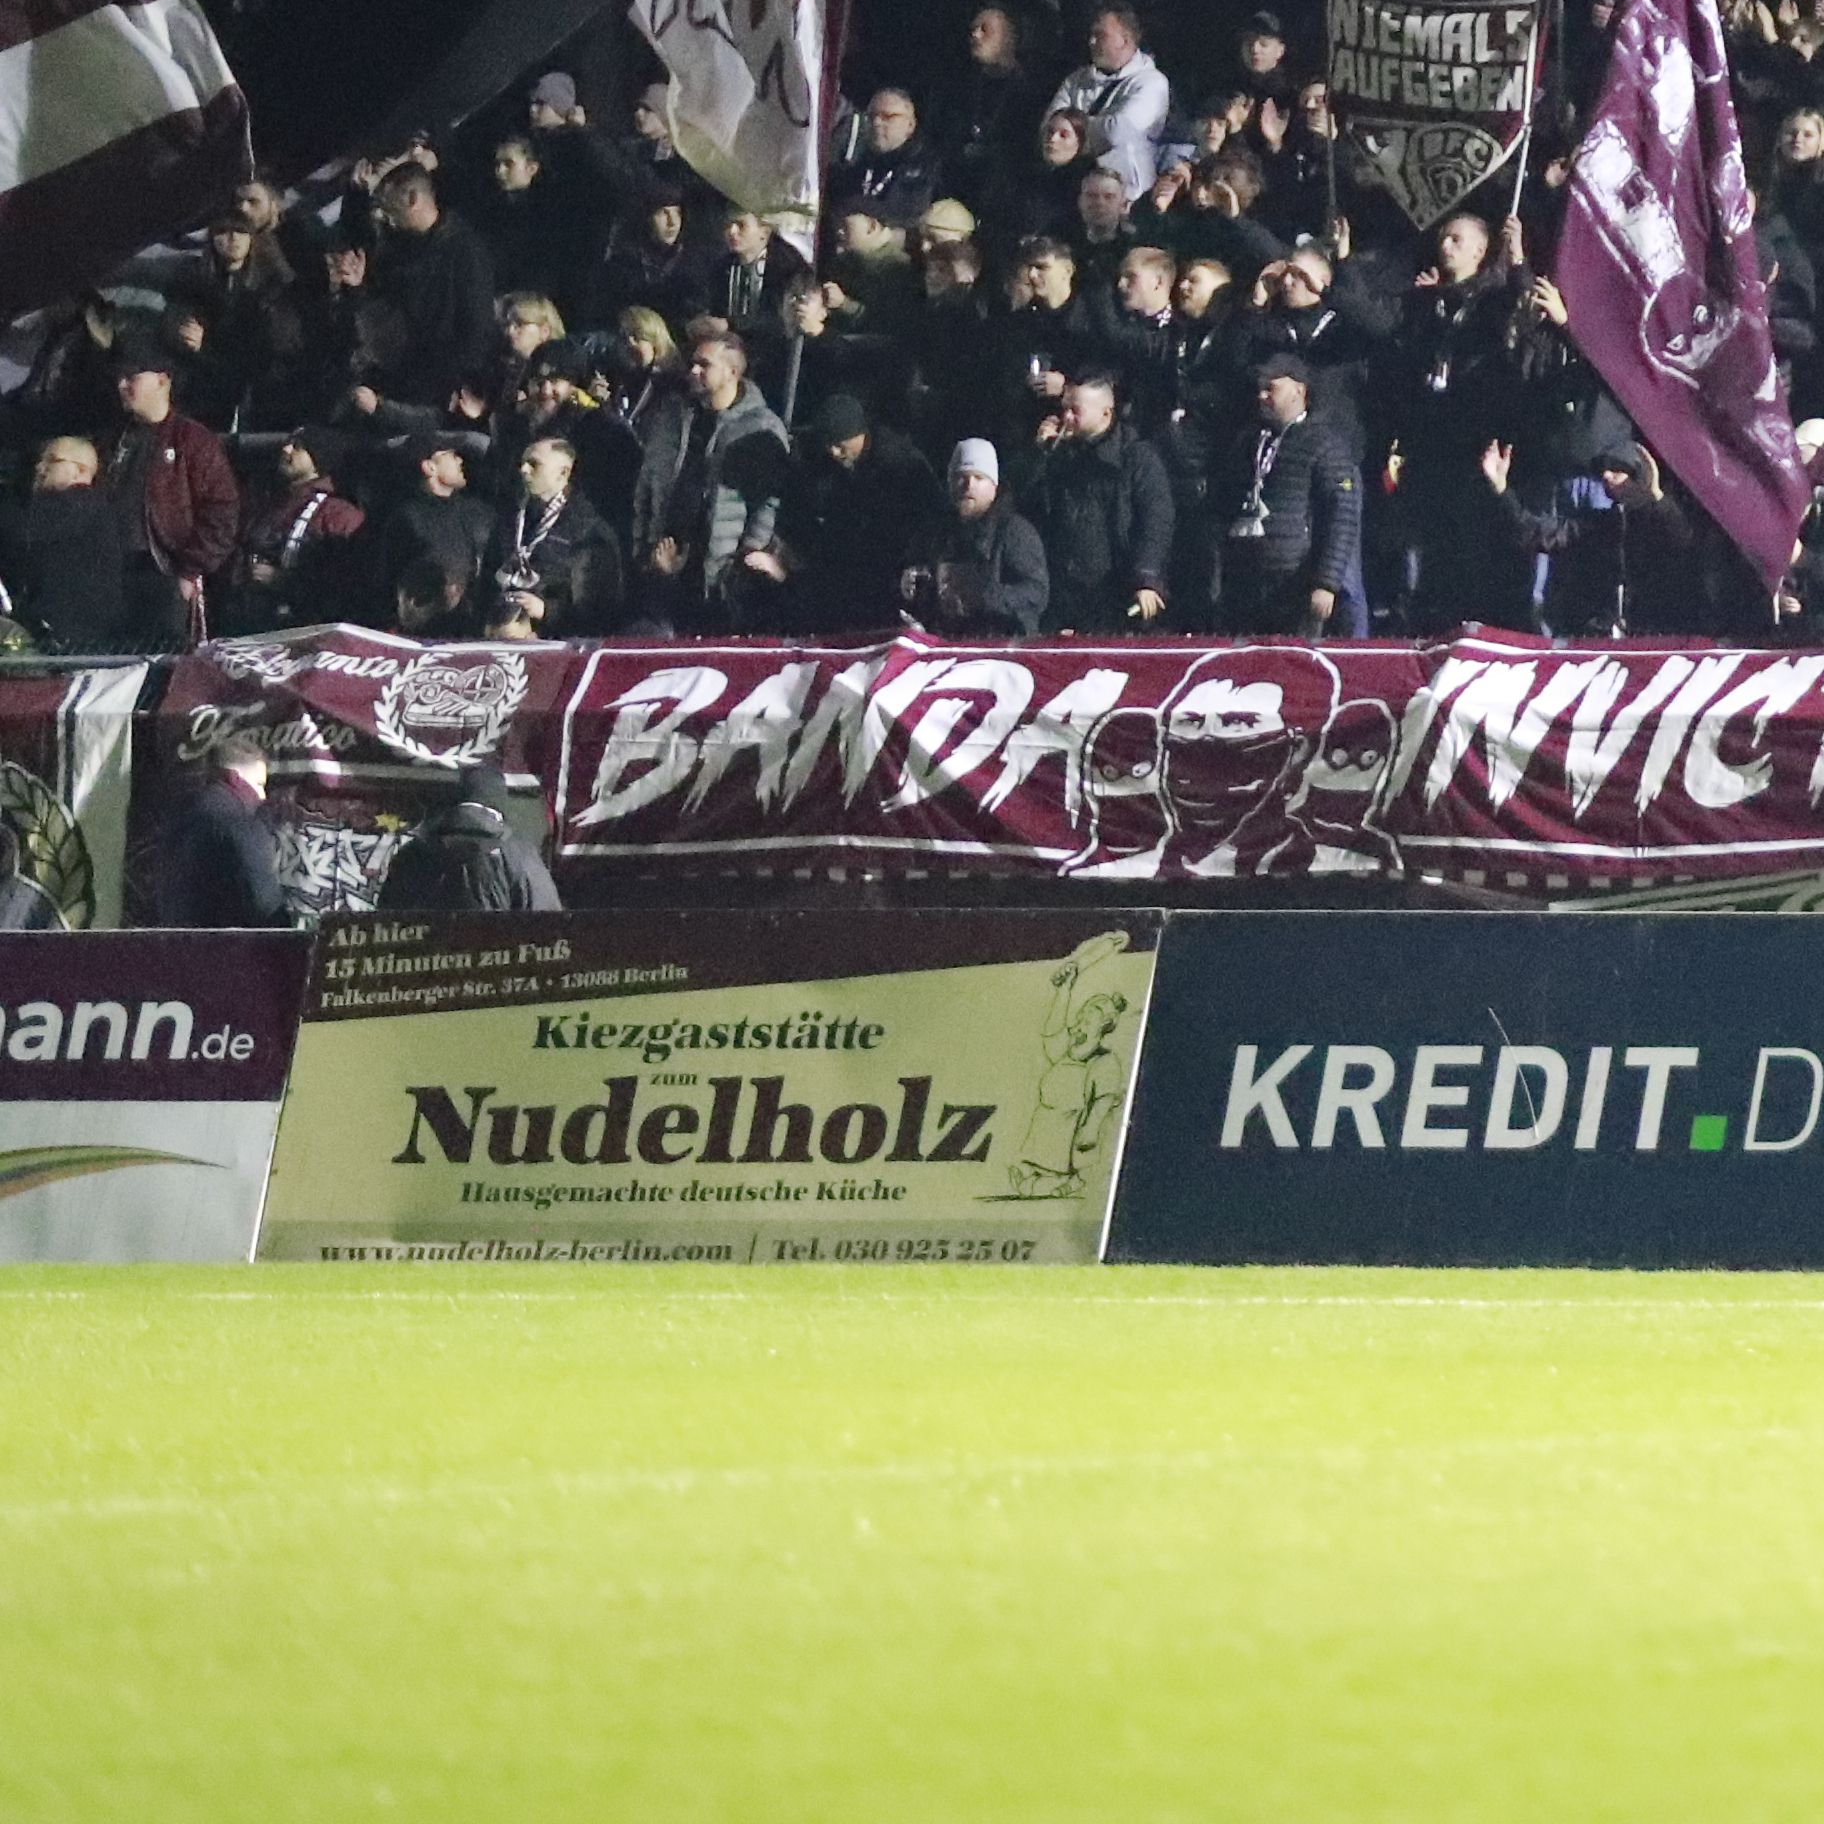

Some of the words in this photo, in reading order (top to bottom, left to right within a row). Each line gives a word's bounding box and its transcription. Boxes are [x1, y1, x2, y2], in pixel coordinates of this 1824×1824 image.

[1331, 46, 1526, 112] AUFGEBEN
[570, 657, 1129, 829] BANDA
[329, 923, 367, 947] Ab
[372, 921, 430, 944] hier
[324, 957, 356, 980] 15
[360, 950, 474, 978] Minuten
[476, 948, 511, 967] zu
[517, 937, 573, 964] Fuß
[320, 982, 460, 1010] Falkenberger
[462, 979, 498, 997] Str.
[501, 976, 540, 995] 37A
[622, 962, 689, 985] Berlin
[0, 1000, 255, 1062] ann.de
[531, 1010, 886, 1064] Kiezgaststätte
[649, 1072, 699, 1087] zum
[391, 1073, 998, 1165] Nudelholz
[460, 1179, 674, 1210] Hausgemachte
[678, 1178, 810, 1202] deutsche
[815, 1179, 907, 1202] Küche
[319, 1239, 733, 1263] www.nudelholz-berlin.com
[772, 1238, 827, 1262] Tel.
[834, 1239, 890, 1262] 030
[895, 1239, 951, 1262] 925
[955, 1239, 995, 1262] 25
[1000, 1239, 1037, 1262] 07
